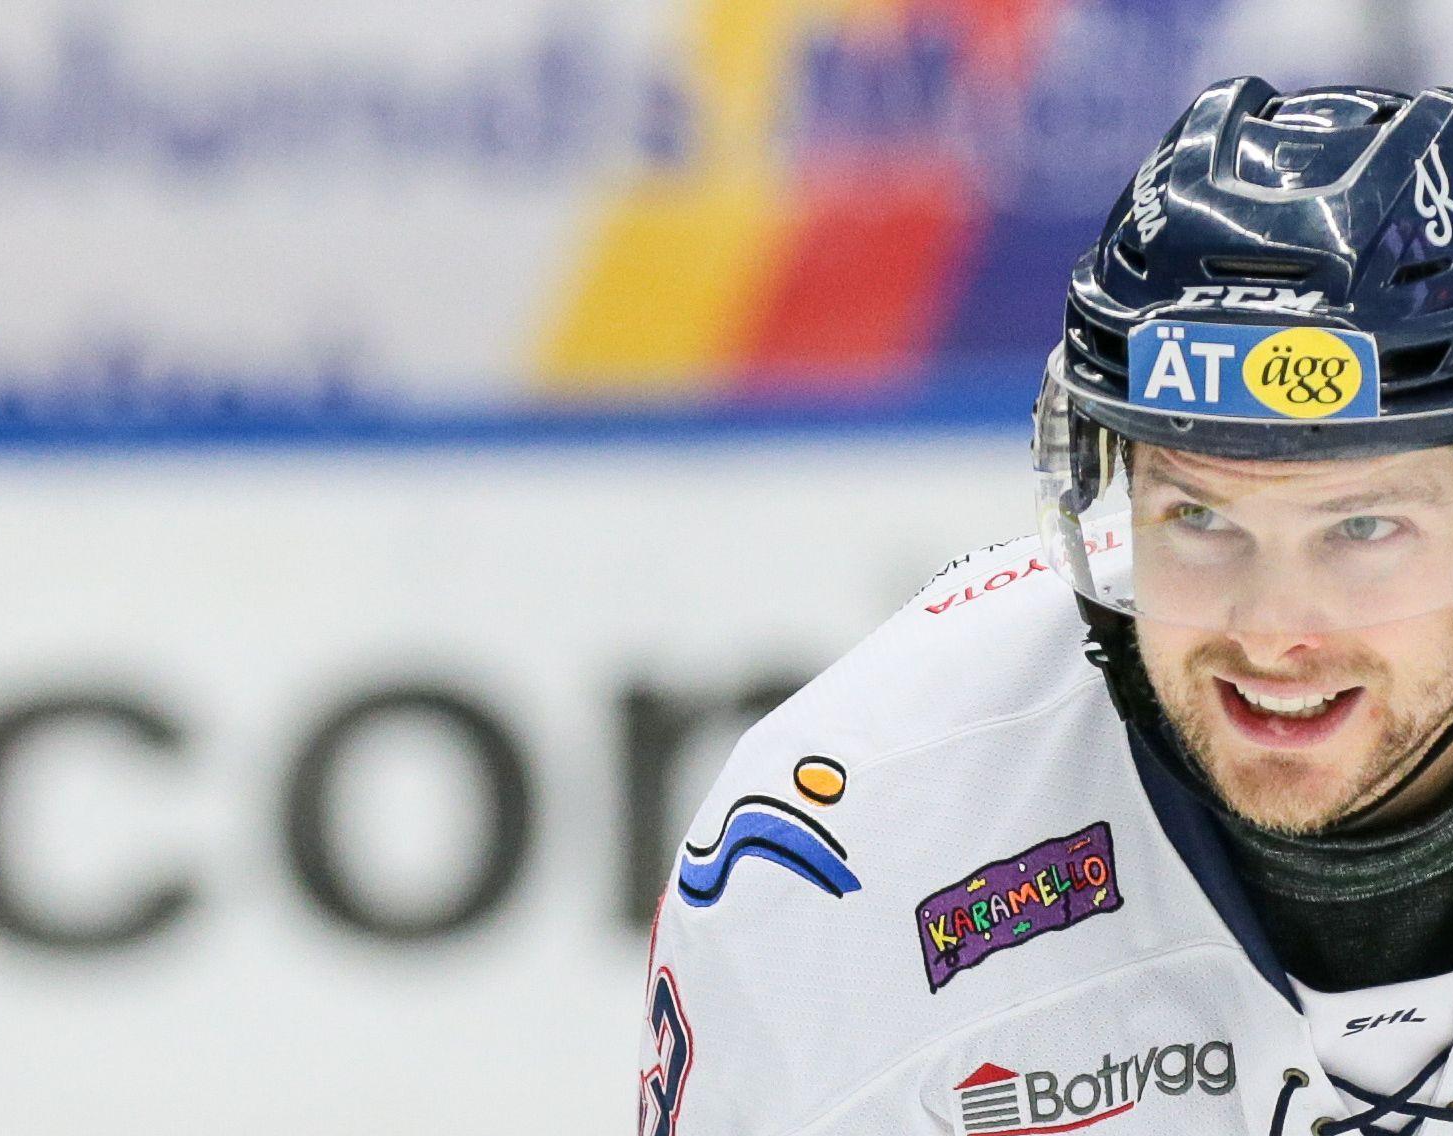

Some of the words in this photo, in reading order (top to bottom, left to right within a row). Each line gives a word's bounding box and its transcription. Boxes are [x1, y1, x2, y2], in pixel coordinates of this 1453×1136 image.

[1177, 285, 1324, 312] CCM
[1143, 326, 1236, 403] ÄT
[1261, 345, 1350, 404] ägg
[929, 855, 1110, 952] KARAMELLO
[1341, 1007, 1428, 1037] SHL
[1025, 1040, 1238, 1124] Botrygg
